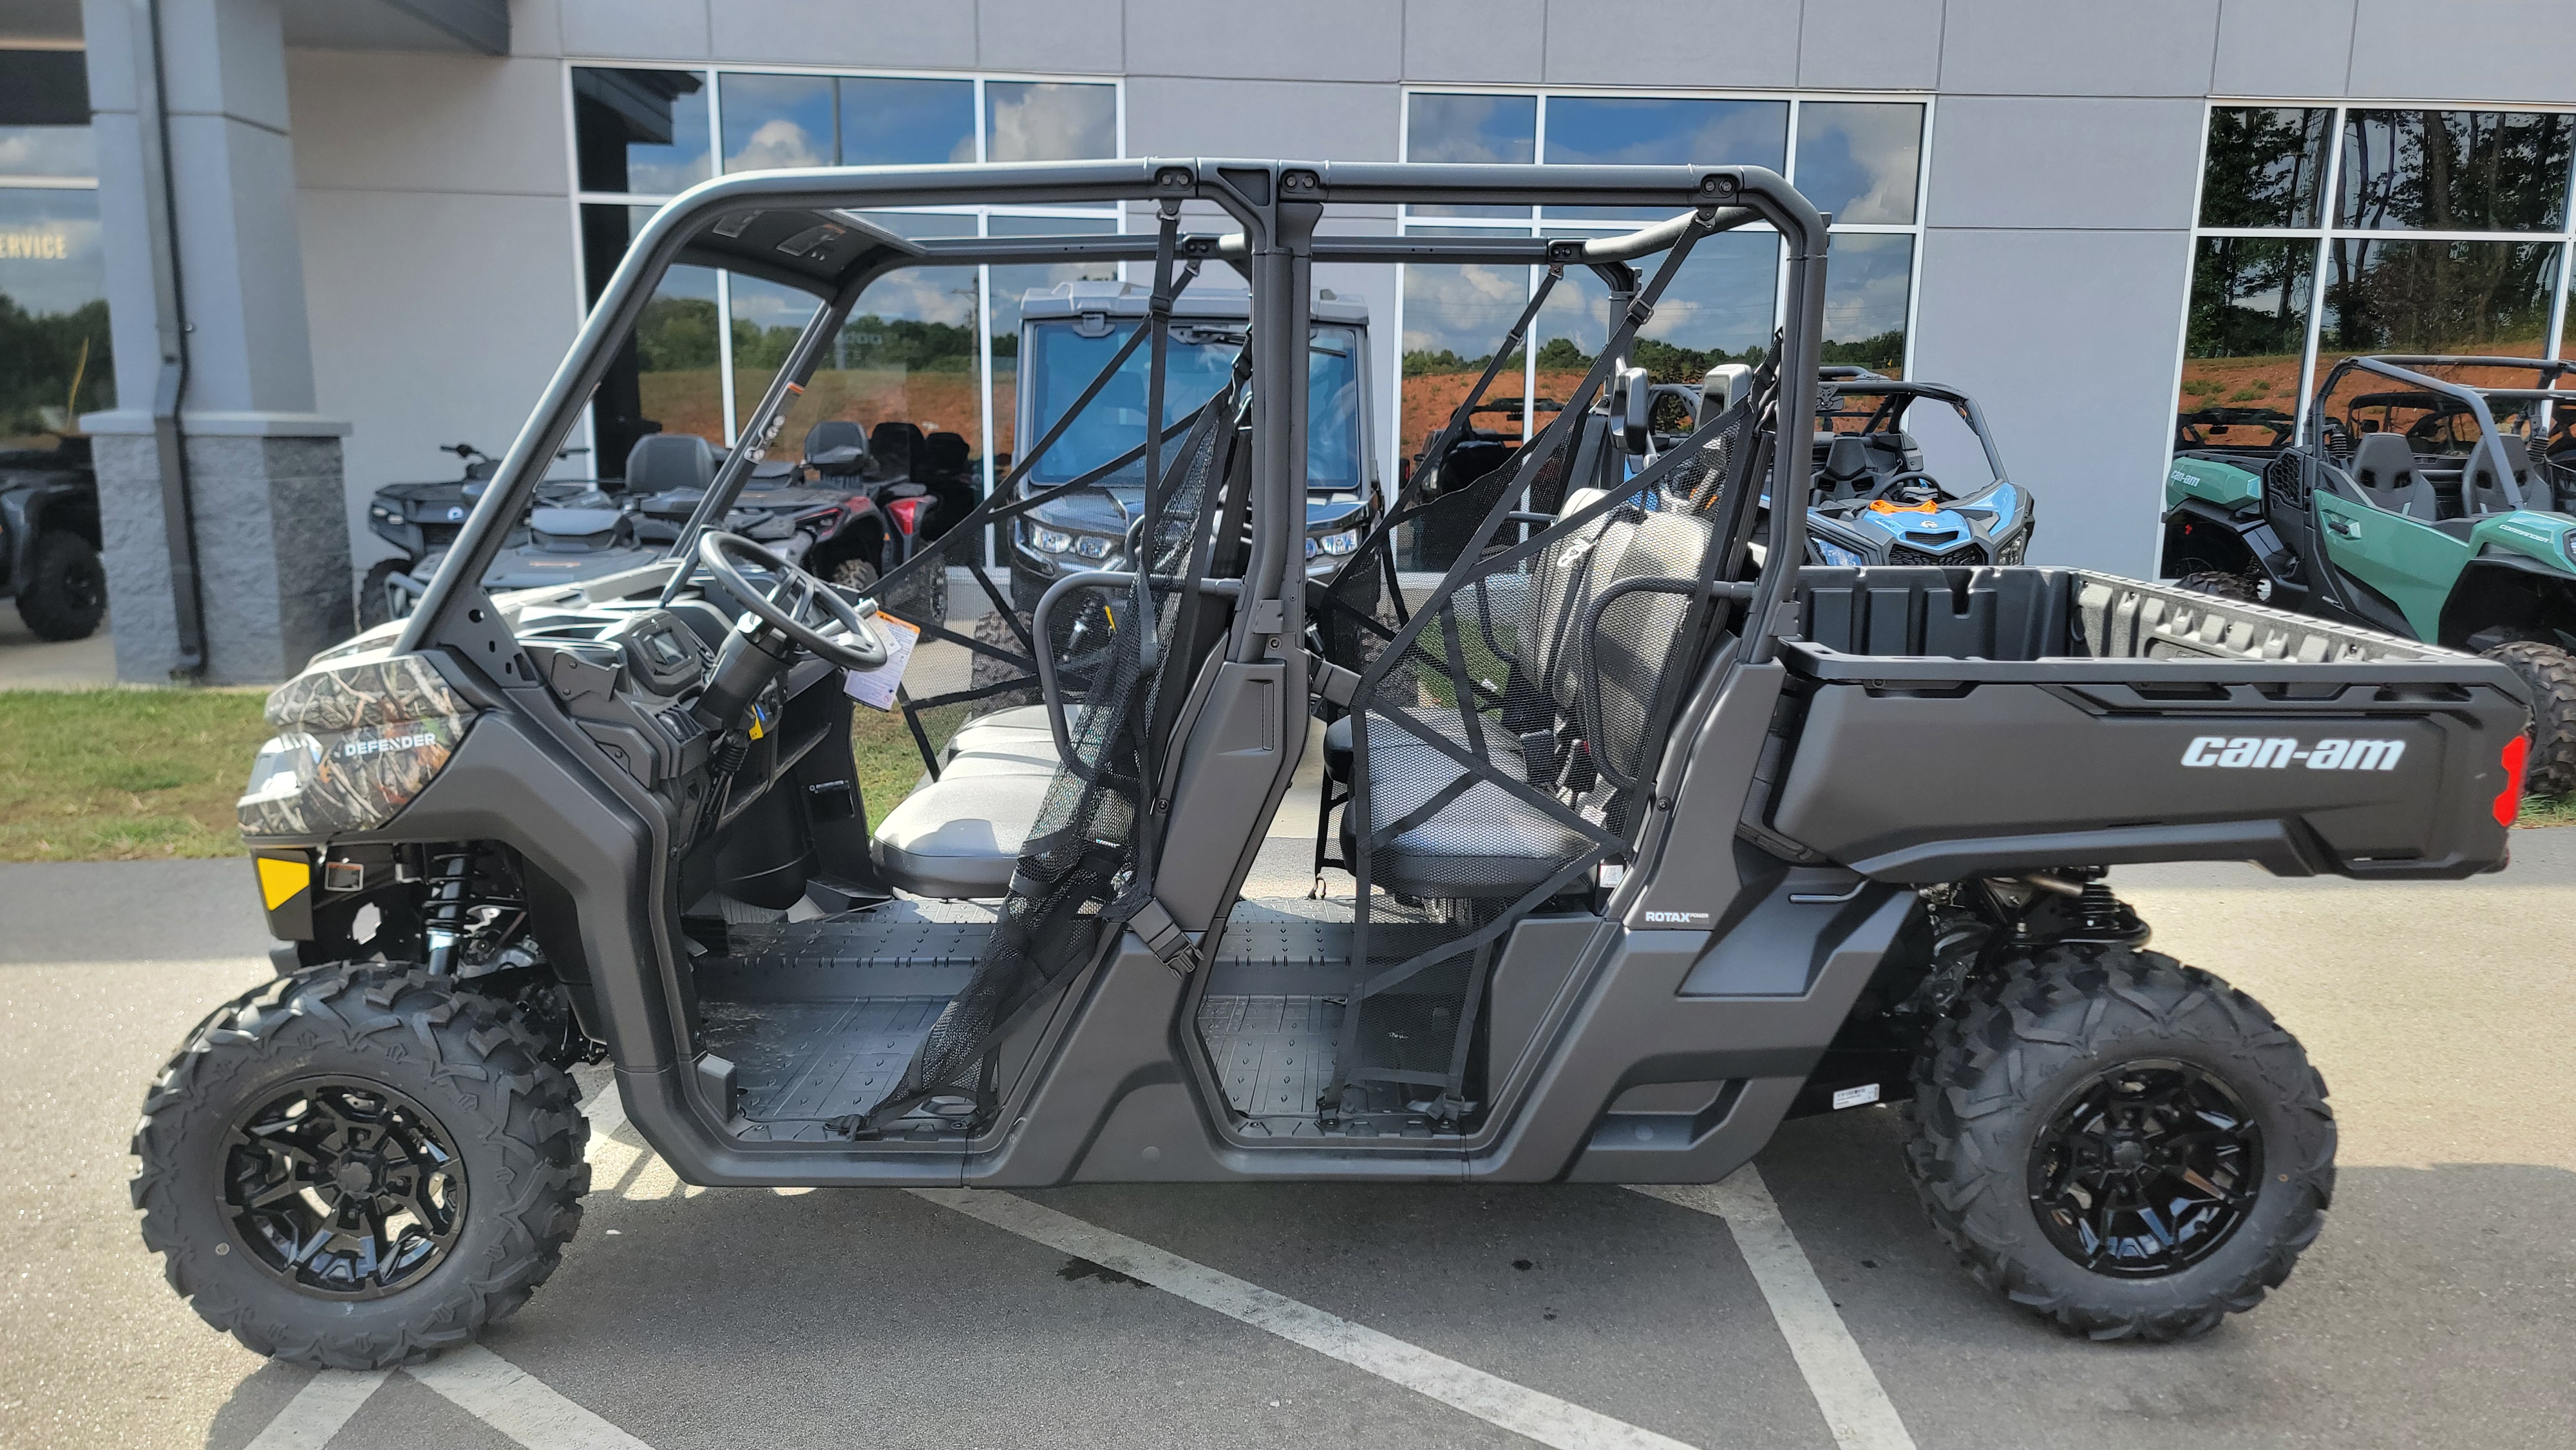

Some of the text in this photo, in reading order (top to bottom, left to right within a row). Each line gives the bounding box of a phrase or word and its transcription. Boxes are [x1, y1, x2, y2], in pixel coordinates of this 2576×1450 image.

[2170, 470, 2201, 487] can-am
[345, 732, 437, 757] DEFENDER
[2181, 737, 2406, 771] can-am
[1645, 911, 1690, 923] ROTAX
